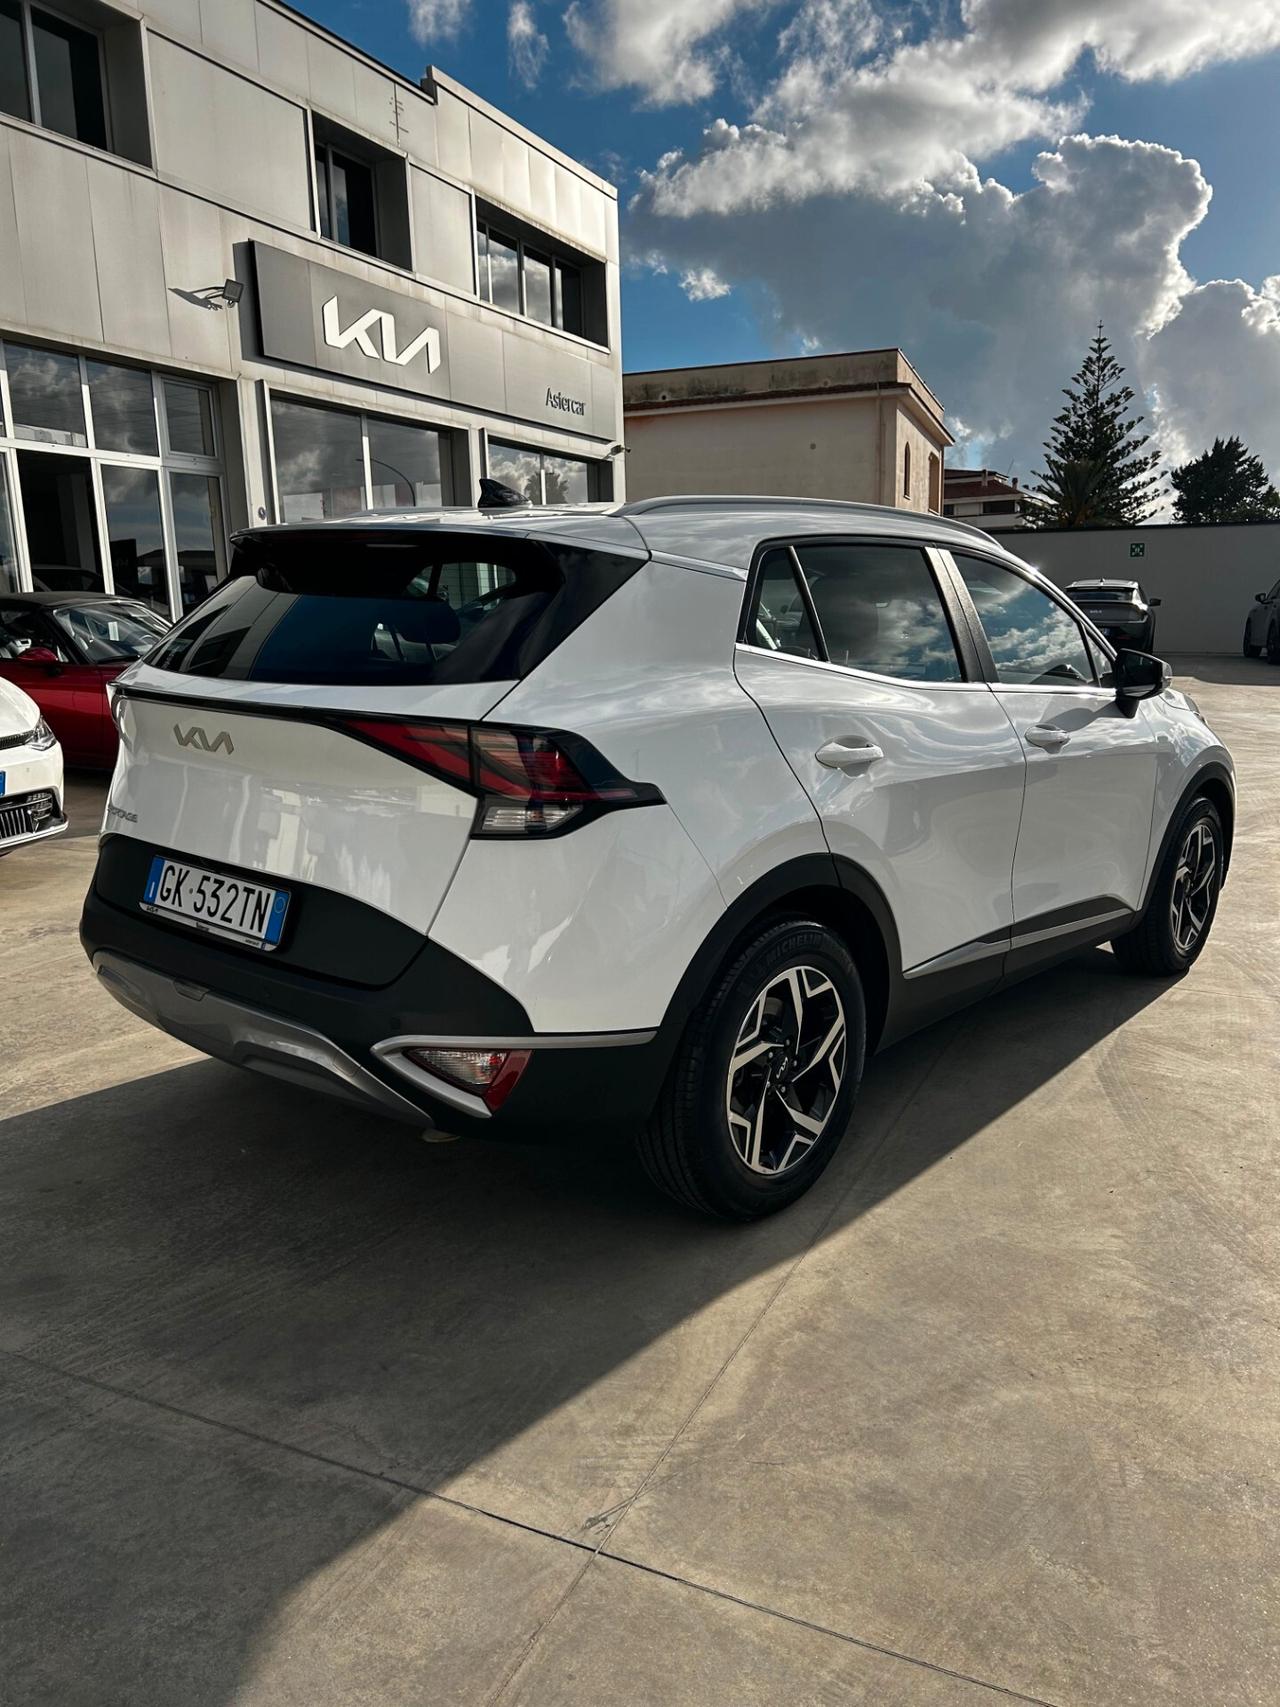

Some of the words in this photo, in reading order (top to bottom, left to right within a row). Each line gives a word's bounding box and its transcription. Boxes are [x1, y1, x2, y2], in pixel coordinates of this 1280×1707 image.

[321, 295, 441, 375] KIA
[545, 387, 586, 417] Astercar
[173, 723, 235, 755] KIA
